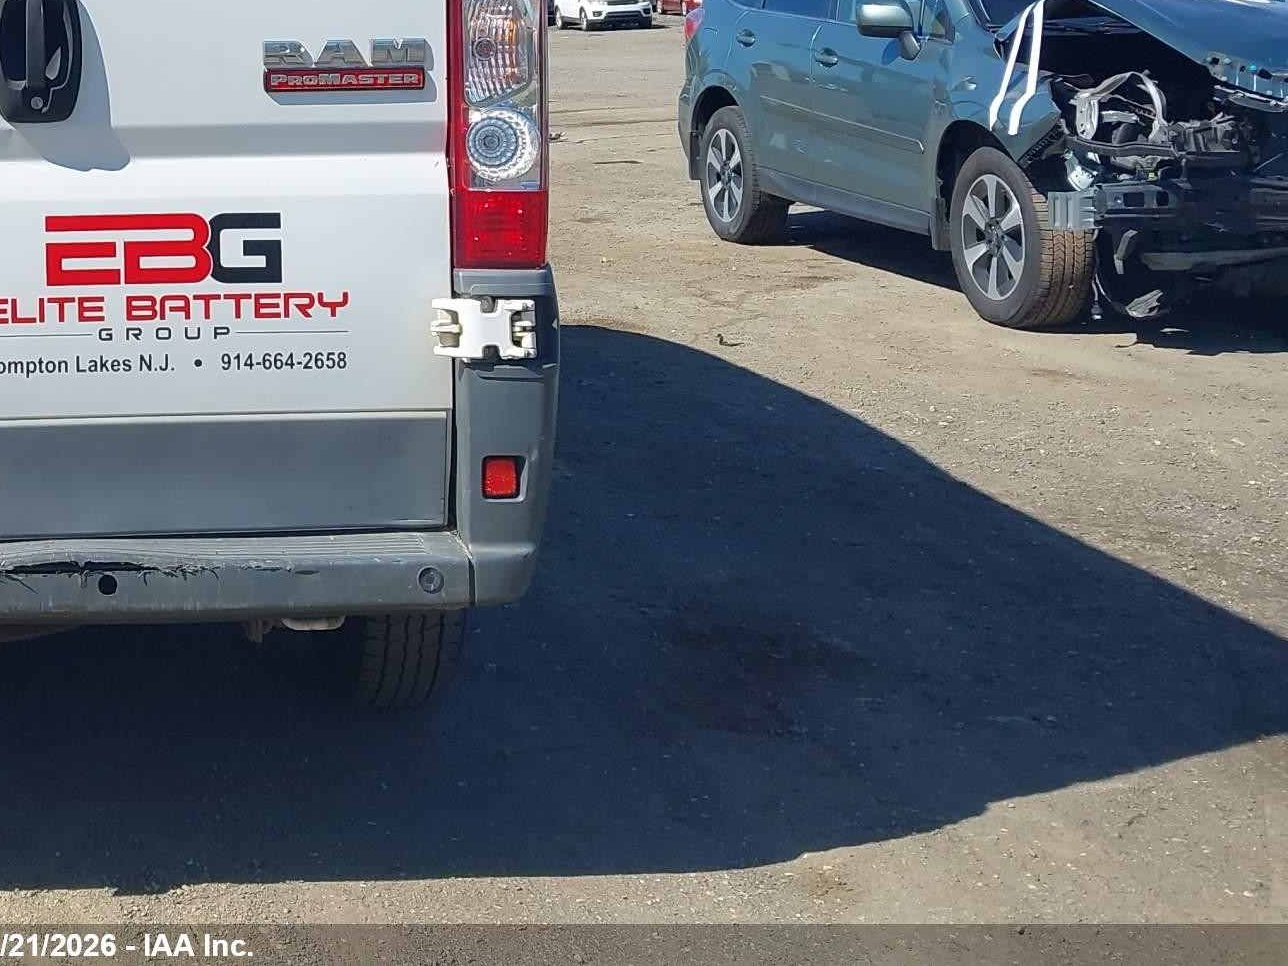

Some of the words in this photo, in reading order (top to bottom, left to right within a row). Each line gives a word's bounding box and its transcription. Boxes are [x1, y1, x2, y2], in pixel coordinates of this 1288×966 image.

[263, 39, 425, 65] RAM
[45, 213, 282, 286] EBG
[126, 293, 349, 321] BATTERY
[98, 327, 230, 341] GROUP
[76, 354, 132, 372] Lakes
[138, 353, 175, 372] N.J.
[221, 352, 348, 371] 914-664-2658
